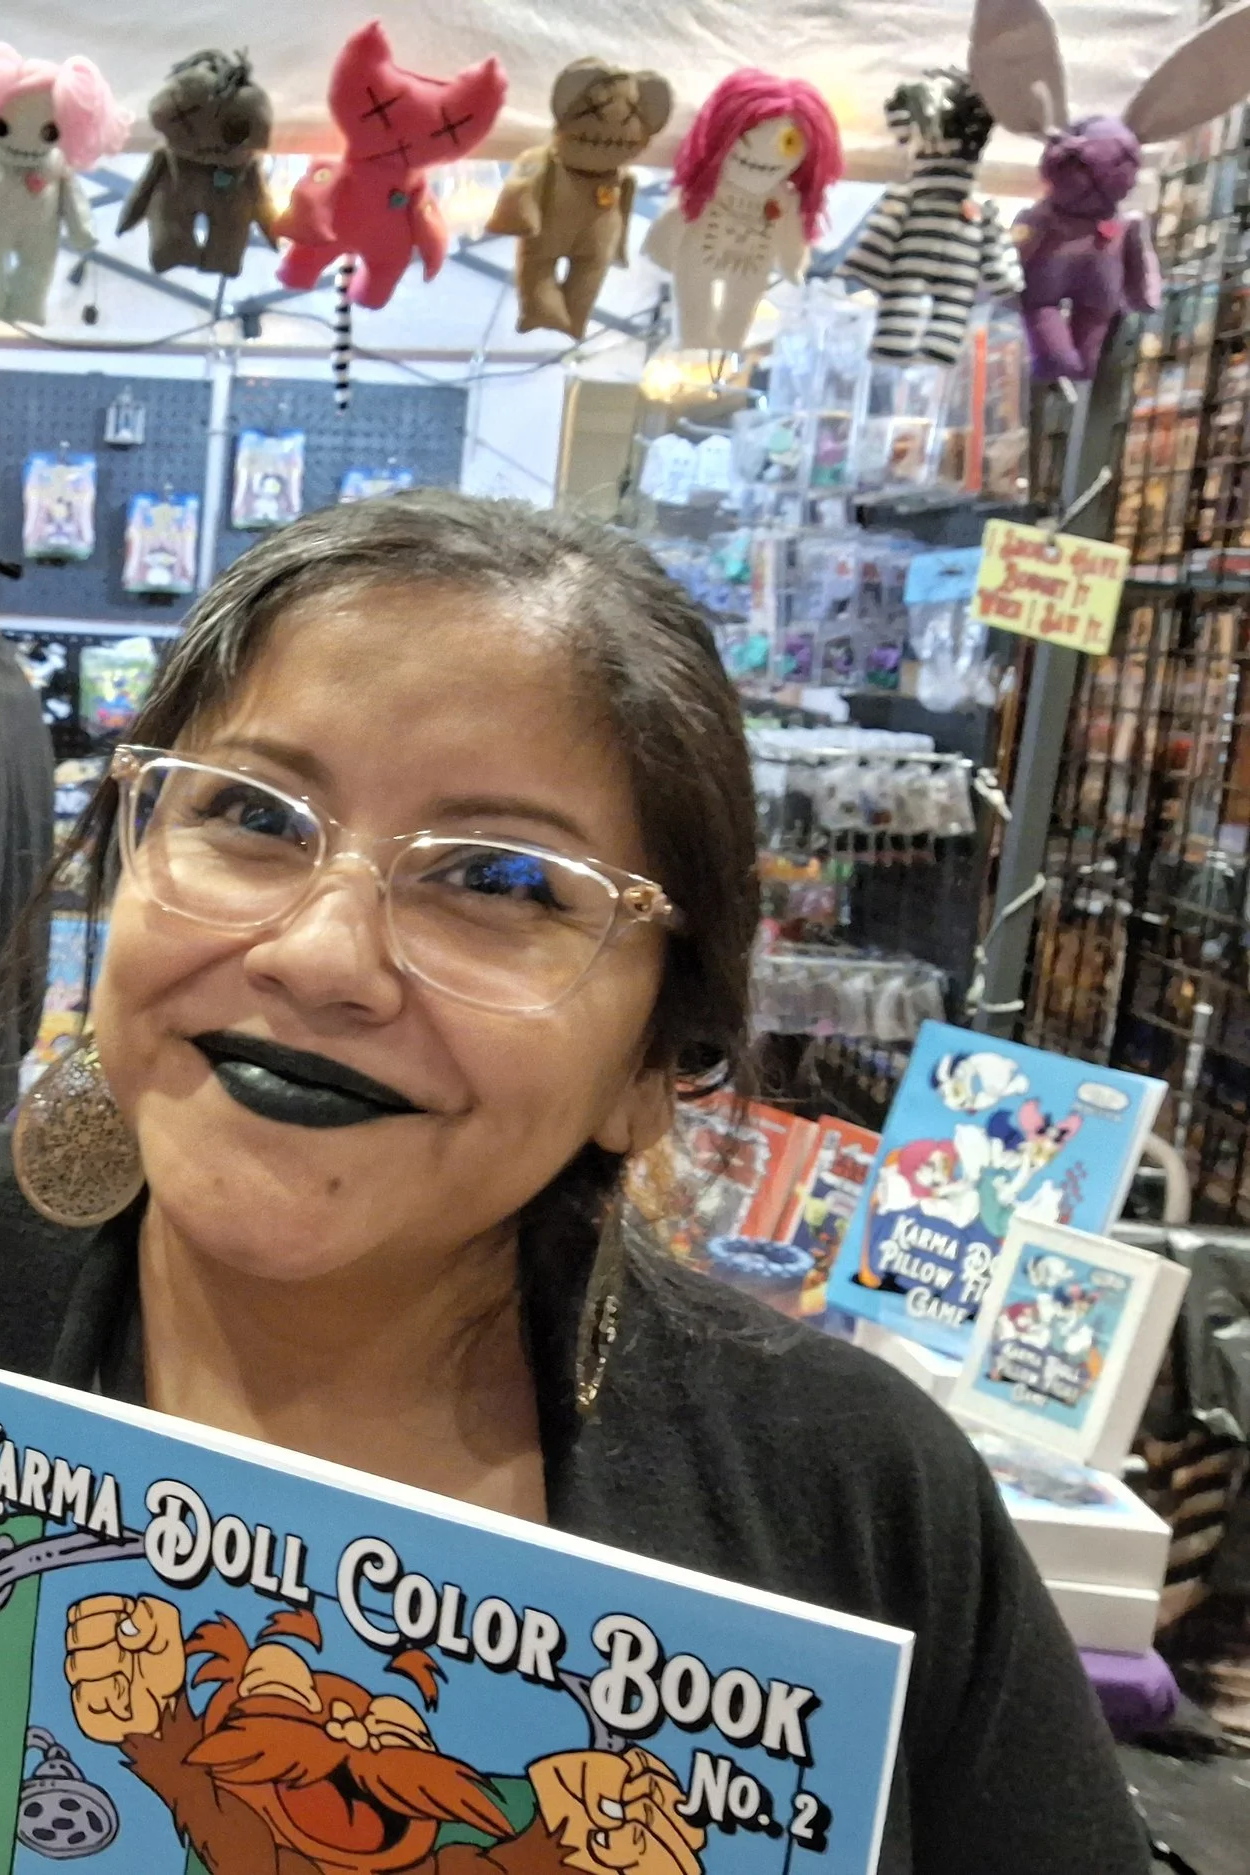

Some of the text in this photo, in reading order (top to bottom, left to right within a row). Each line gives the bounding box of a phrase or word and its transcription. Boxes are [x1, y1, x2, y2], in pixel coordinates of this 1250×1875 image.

[891, 1214, 959, 1261] KARMA
[878, 1239, 956, 1289] PILLOW
[905, 1286, 968, 1328] GAME
[144, 1478, 312, 1605] DOLL
[336, 1536, 562, 1684] COLOR
[588, 1612, 816, 1760] BOOK
[789, 1792, 821, 1842] 2
